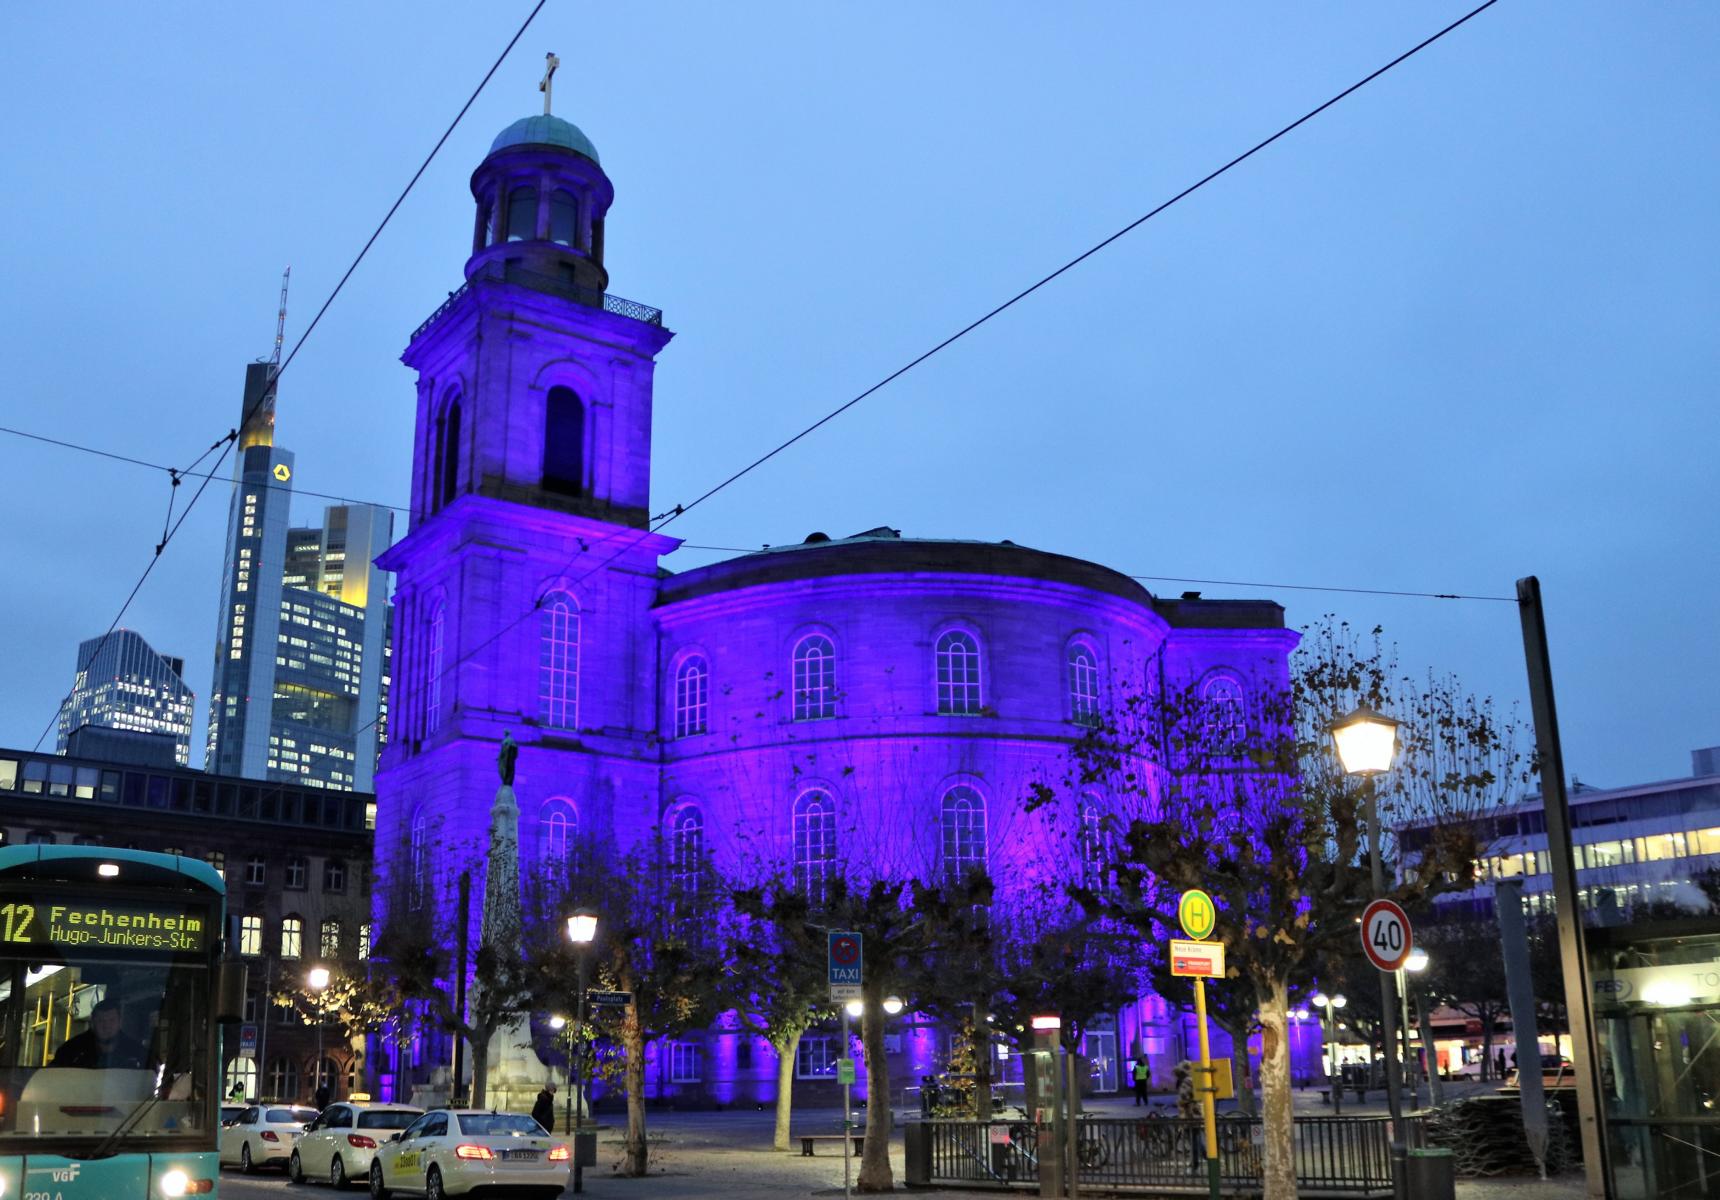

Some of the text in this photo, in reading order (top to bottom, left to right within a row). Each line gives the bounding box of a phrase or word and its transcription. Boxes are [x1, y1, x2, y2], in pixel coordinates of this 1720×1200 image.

[1, 903, 35, 942] 12
[51, 907, 200, 931] Fechenheim
[1191, 902, 1203, 928] H
[50, 925, 198, 949] Hugo-Junkers-Str.
[1374, 921, 1402, 951] 40
[832, 968, 858, 979] TAXI
[52, 1163, 80, 1182] VGF
